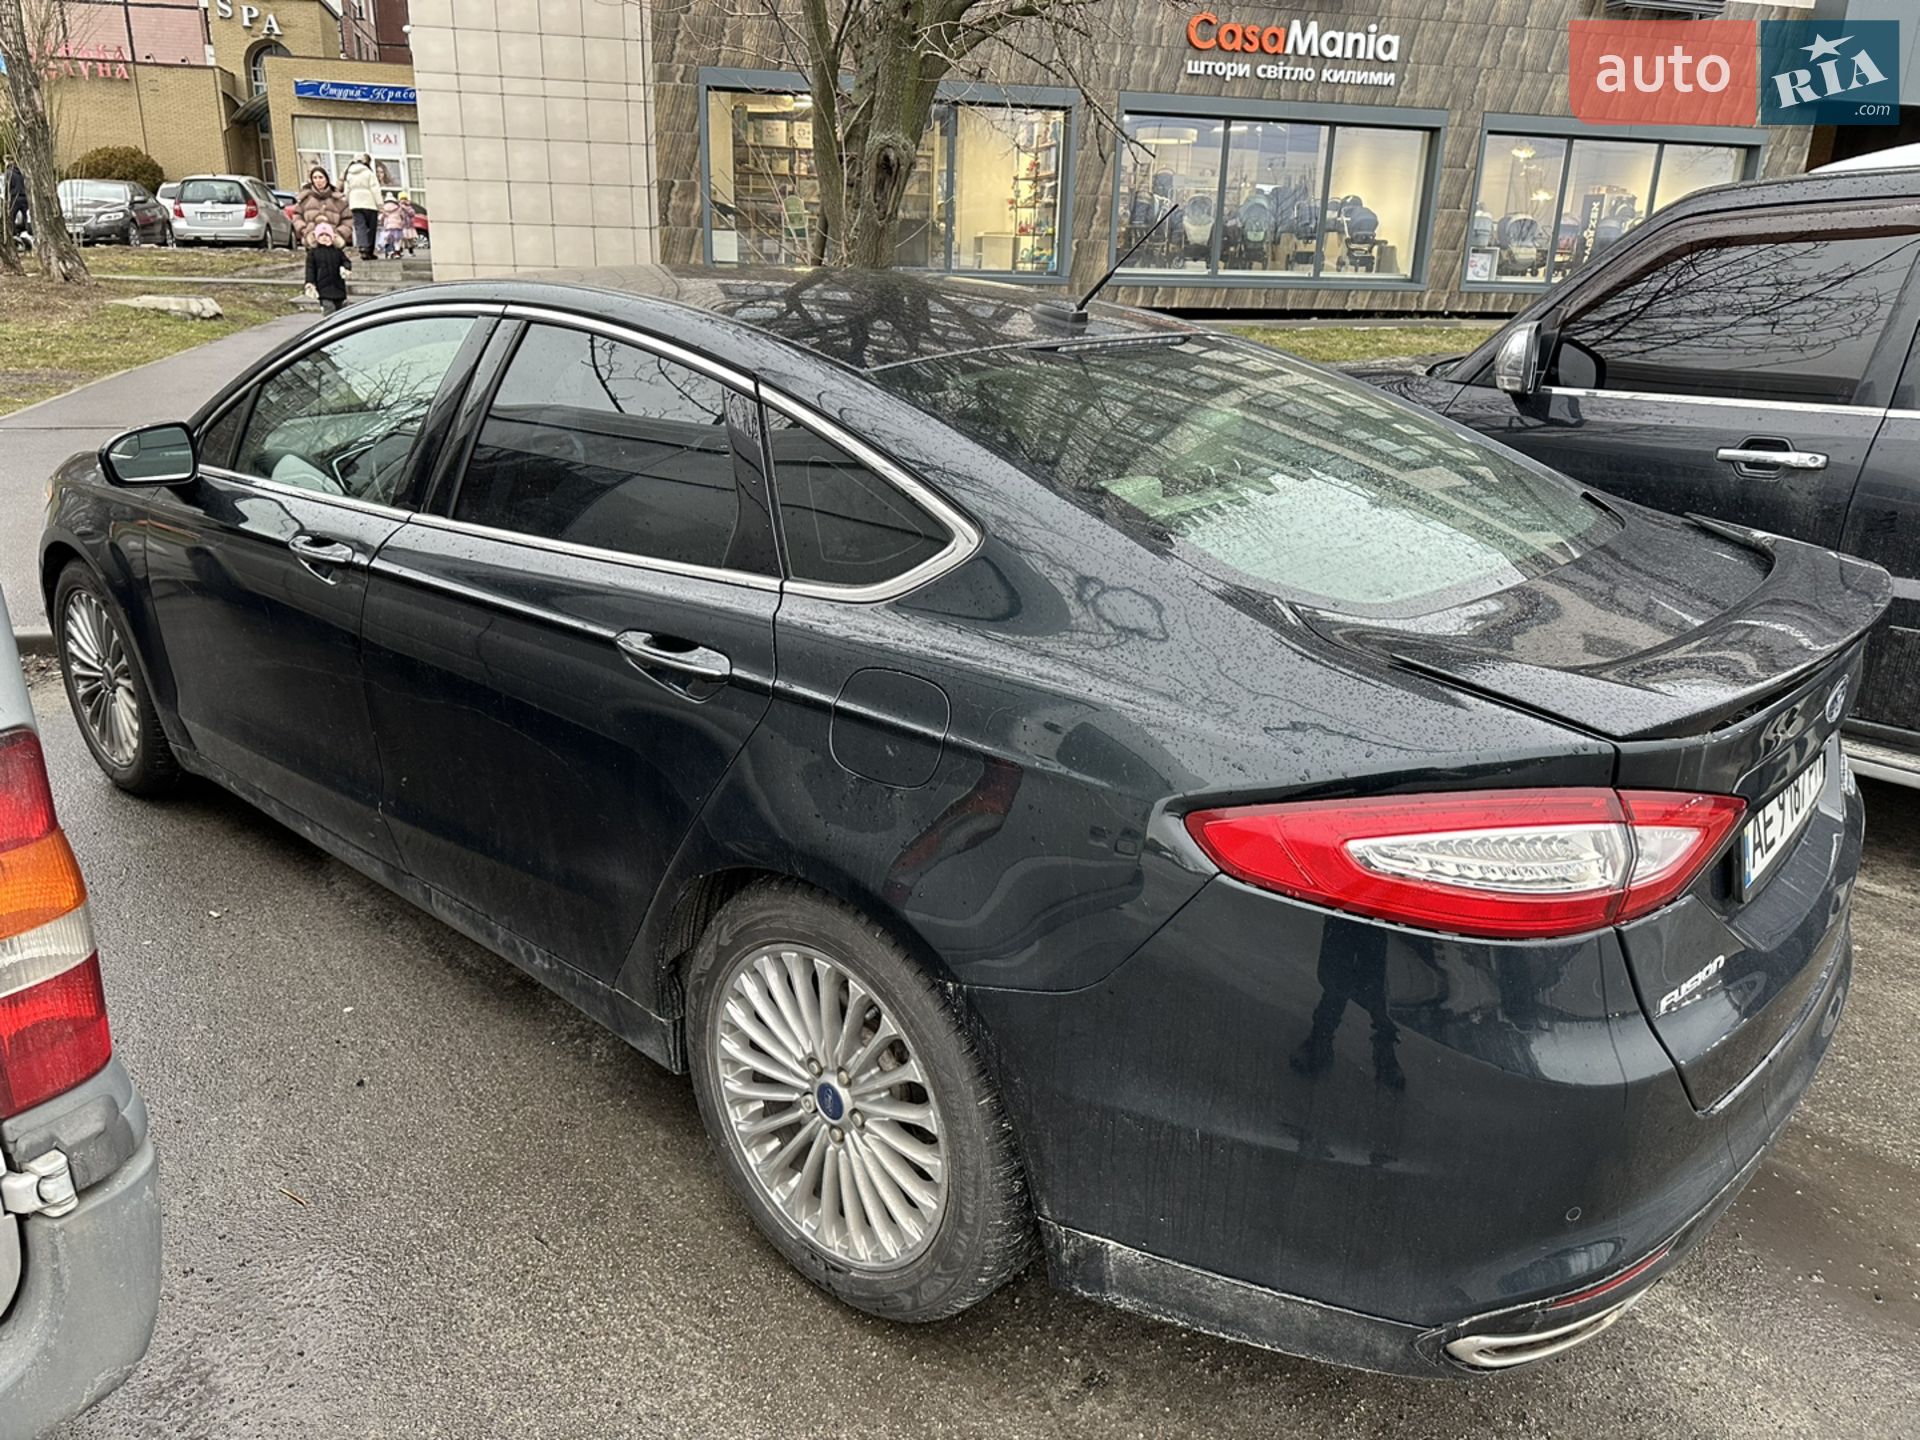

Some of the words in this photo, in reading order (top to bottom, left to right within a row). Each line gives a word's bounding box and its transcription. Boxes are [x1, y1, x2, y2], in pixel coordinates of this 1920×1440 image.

[216, 0, 283, 36] SPA
[1187, 12, 1400, 62] CasaMania
[1187, 58, 1251, 82] штори
[1256, 61, 1316, 83] світло
[1321, 66, 1396, 87] килими
[1752, 807, 1776, 869] AE
